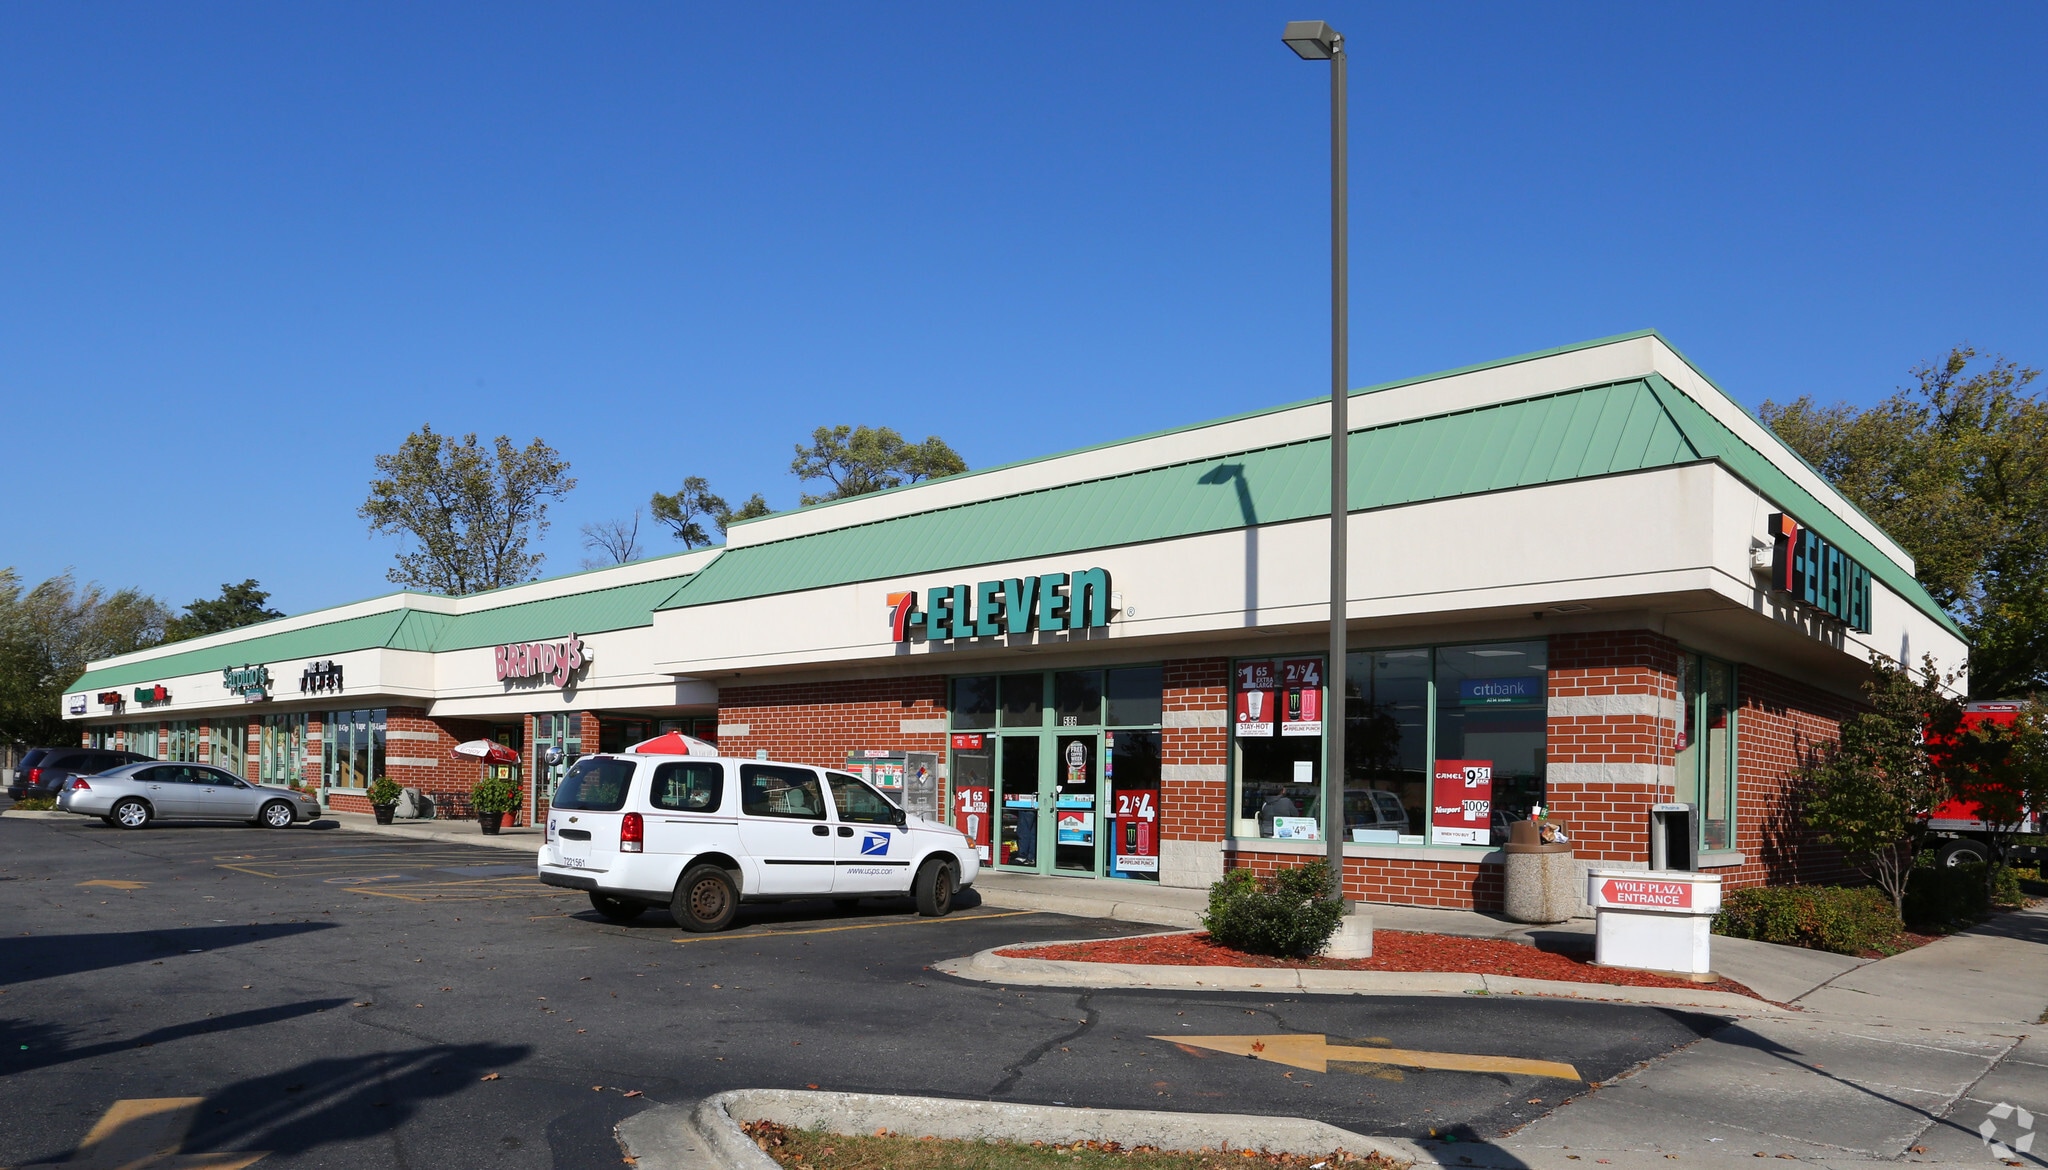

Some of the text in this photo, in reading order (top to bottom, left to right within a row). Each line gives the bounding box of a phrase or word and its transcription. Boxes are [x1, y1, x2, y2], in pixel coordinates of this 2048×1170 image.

[223, 665, 266, 696] Sarpino's
[1473, 682, 1525, 696] citibank
[1434, 806, 1461, 815] Newport
[1471, 831, 1477, 841] 1
[1614, 882, 1684, 895] WOLF PLAZA
[1617, 892, 1680, 905] ENTRANCE
